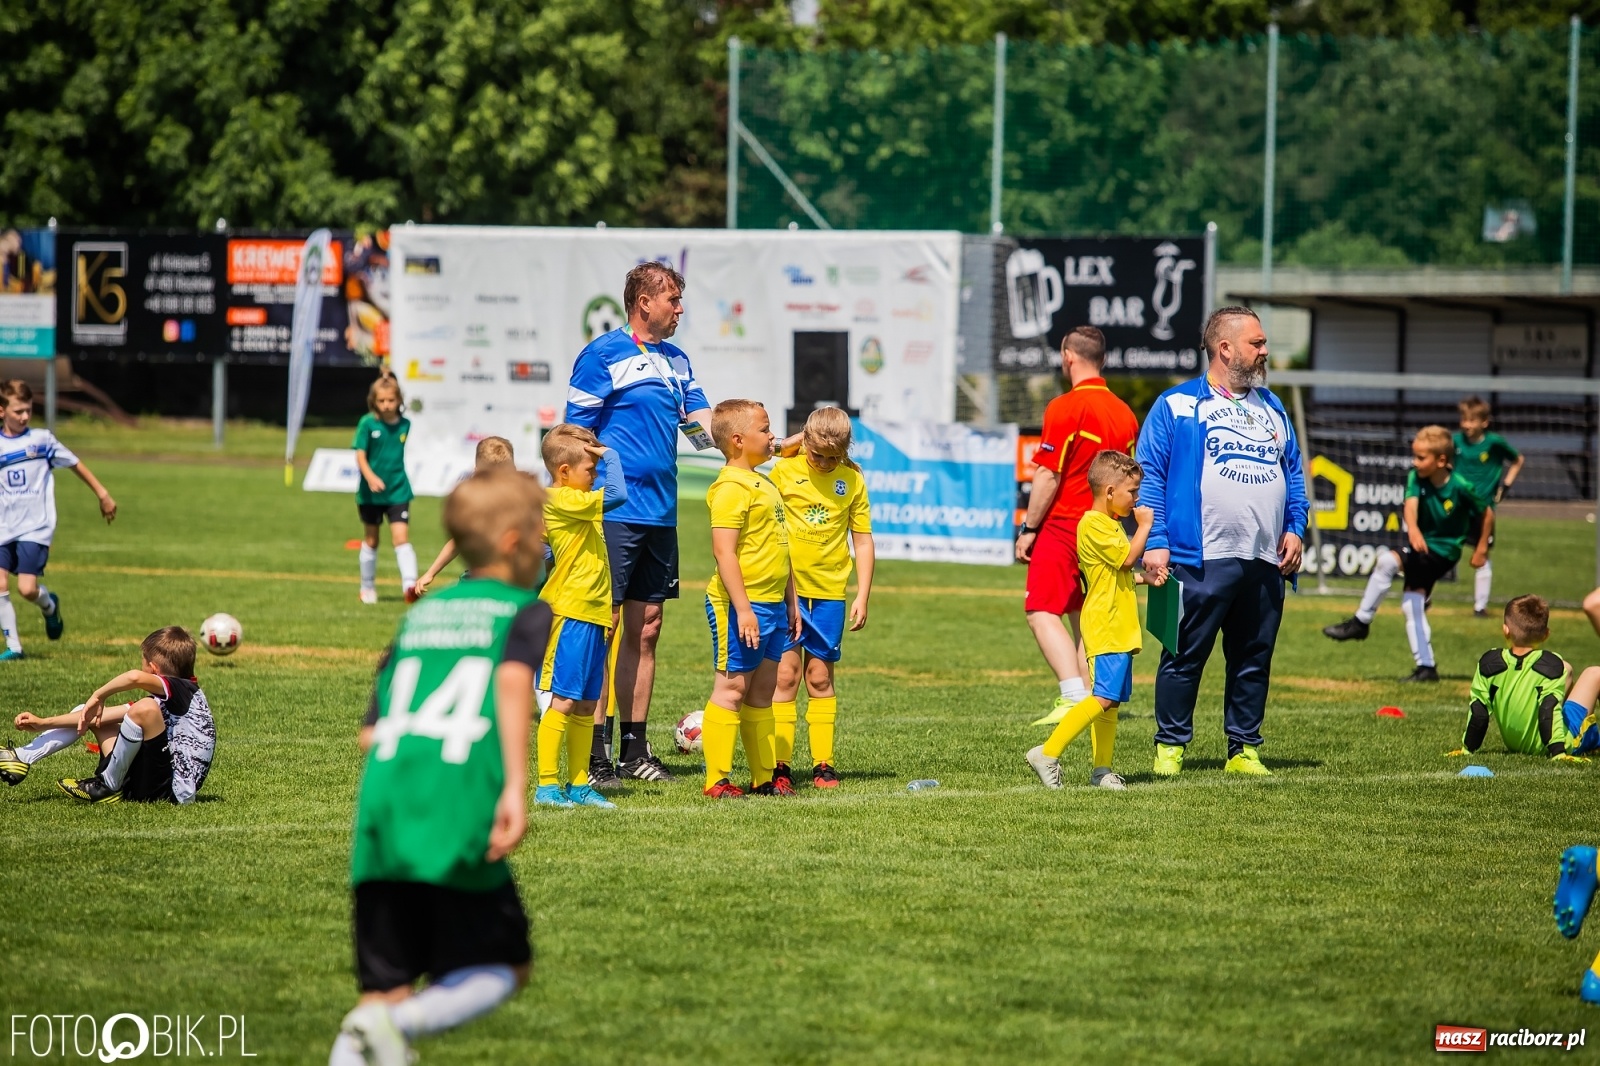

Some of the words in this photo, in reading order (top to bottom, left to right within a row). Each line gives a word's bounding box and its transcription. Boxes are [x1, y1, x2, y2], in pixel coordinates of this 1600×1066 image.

[1064, 255, 1115, 286] LEX
[1089, 295, 1145, 328] BAR
[1207, 407, 1233, 422] WEST
[1230, 418, 1254, 426] VINTA
[1219, 466, 1278, 485] ORIGINALS
[1355, 483, 1405, 505] BUDU
[1353, 510, 1384, 532] OD
